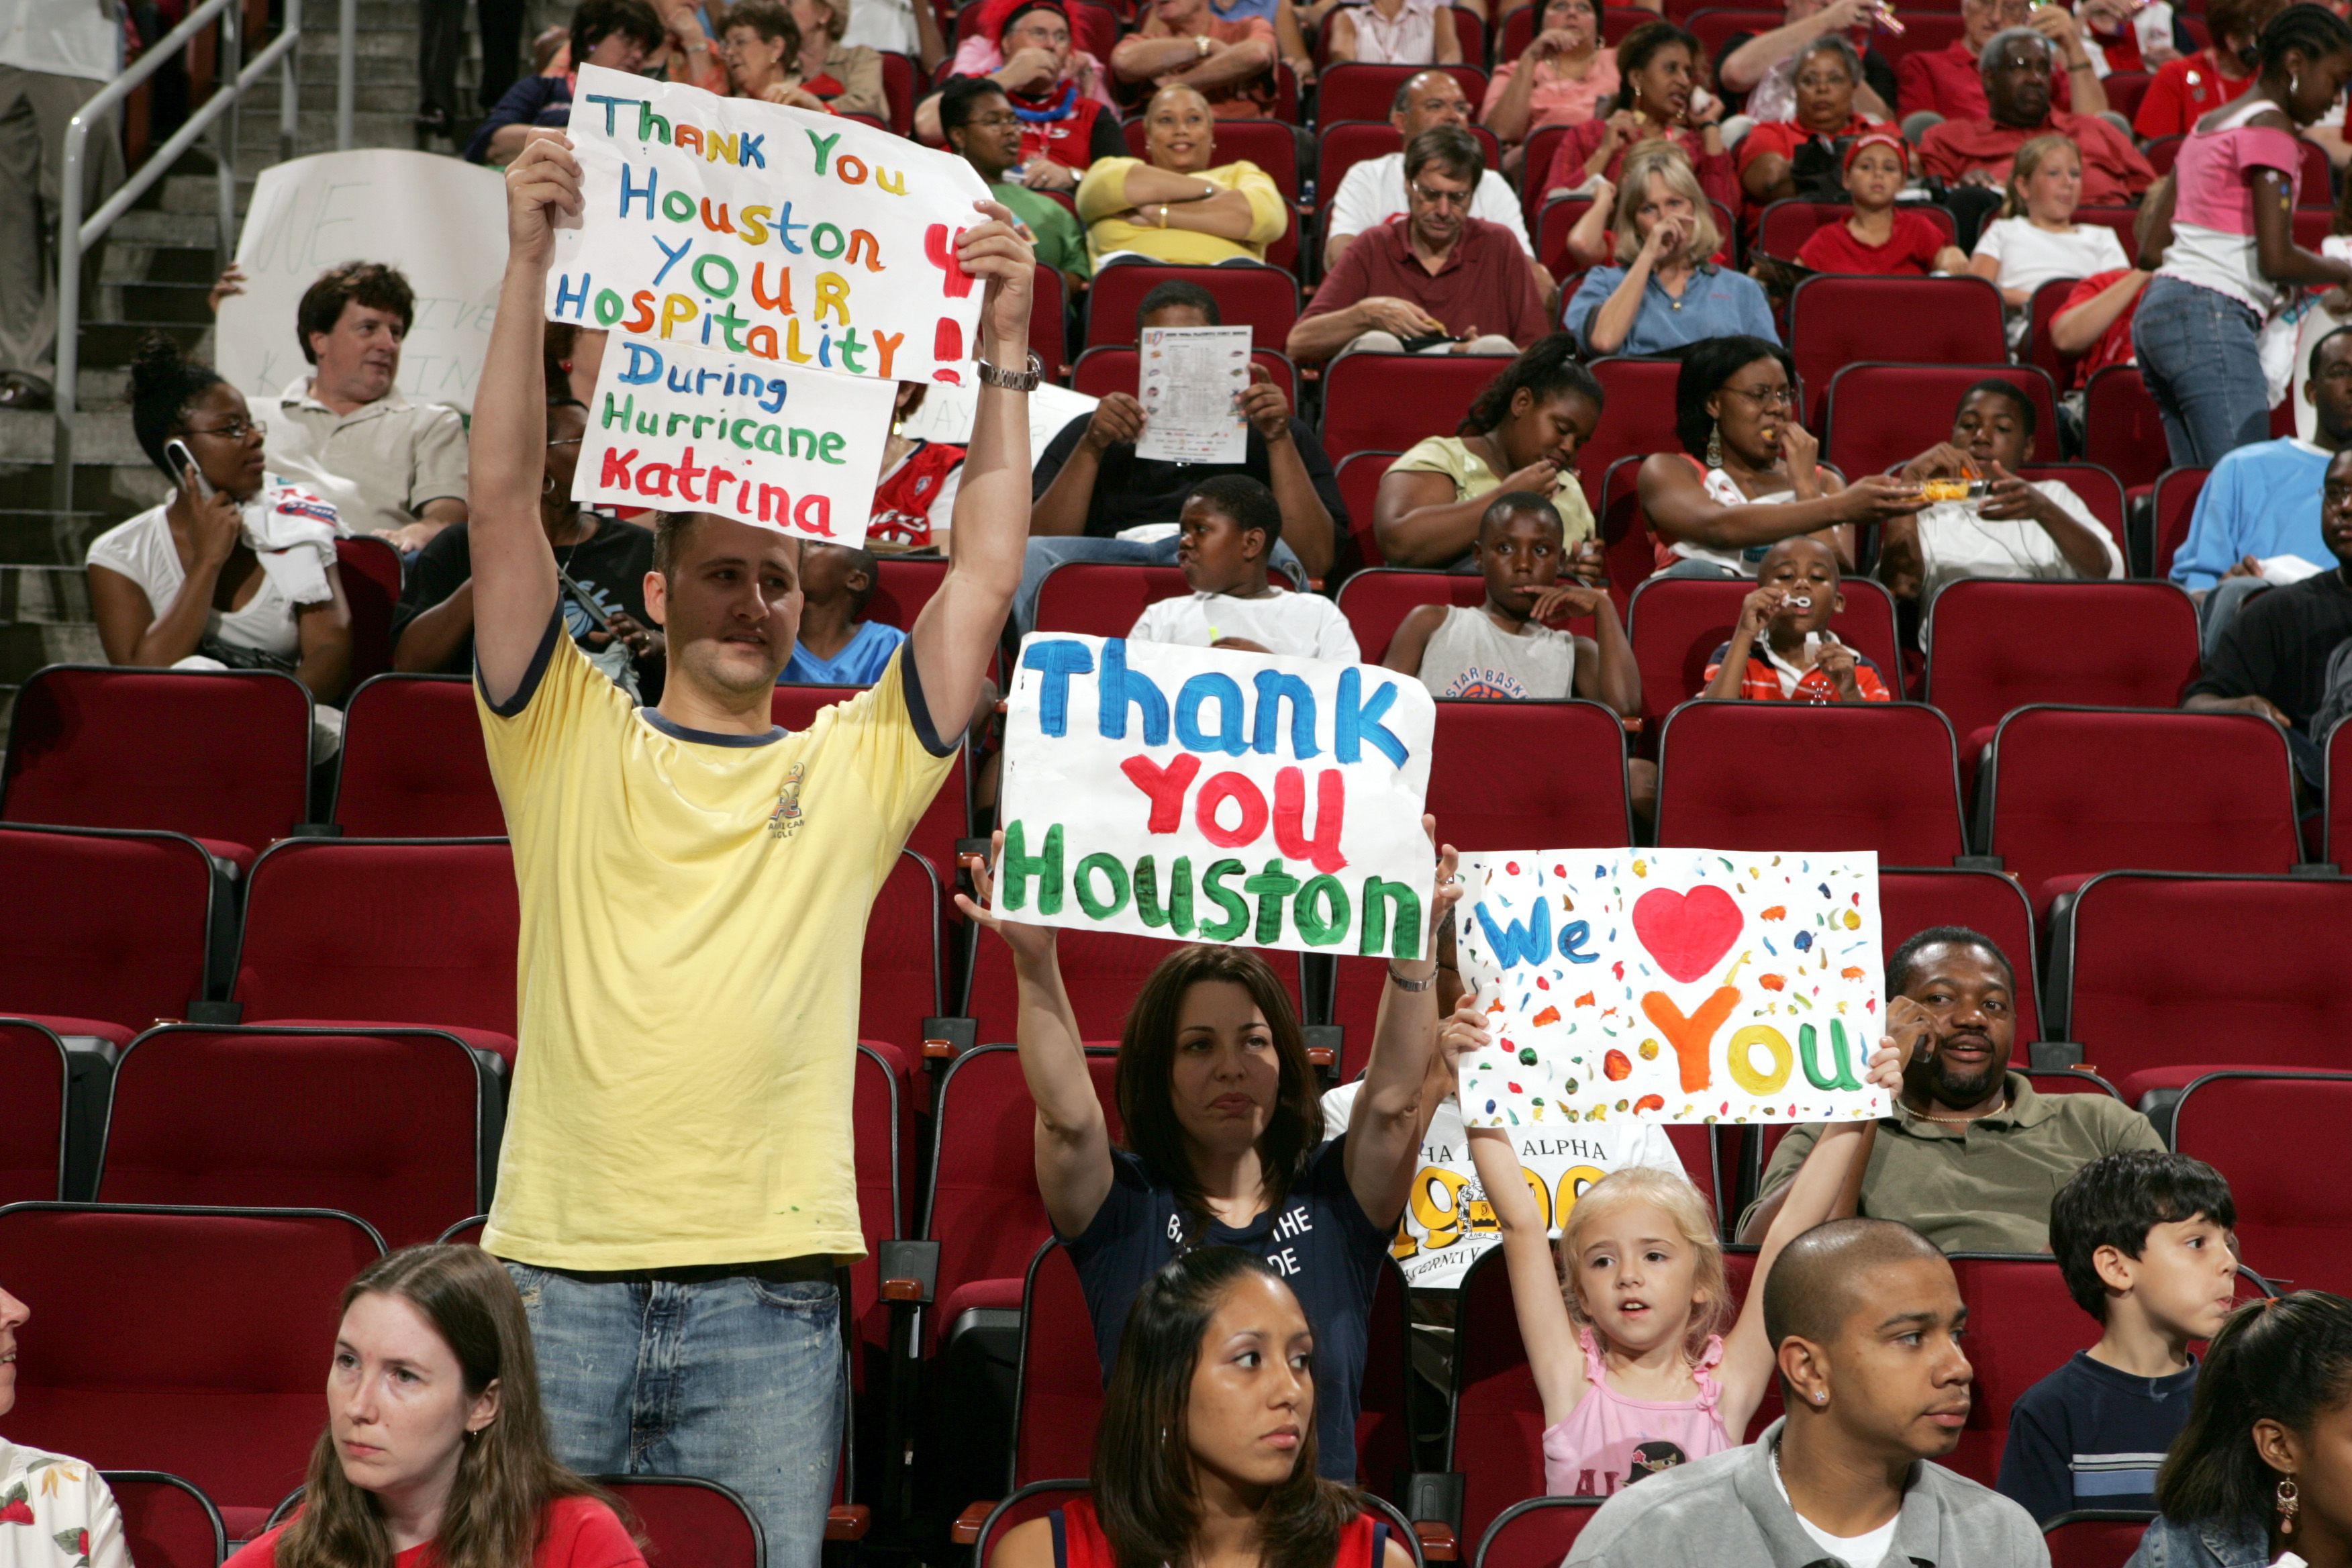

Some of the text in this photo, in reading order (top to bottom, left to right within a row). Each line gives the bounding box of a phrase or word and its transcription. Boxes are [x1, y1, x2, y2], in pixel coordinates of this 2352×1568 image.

[805, 129, 909, 196] You
[620, 163, 886, 272] Houston
[618, 342, 787, 413] During
[601, 392, 846, 464] Hurricane
[599, 446, 836, 538] Katrina
[1022, 636, 1410, 770] Thank
[1446, 667, 1479, 698] STAR
[1001, 818, 1420, 959] Houston
[1473, 895, 1601, 970] We
[1640, 985, 1863, 1096] You
[1522, 1139, 1608, 1161] ALPHA
